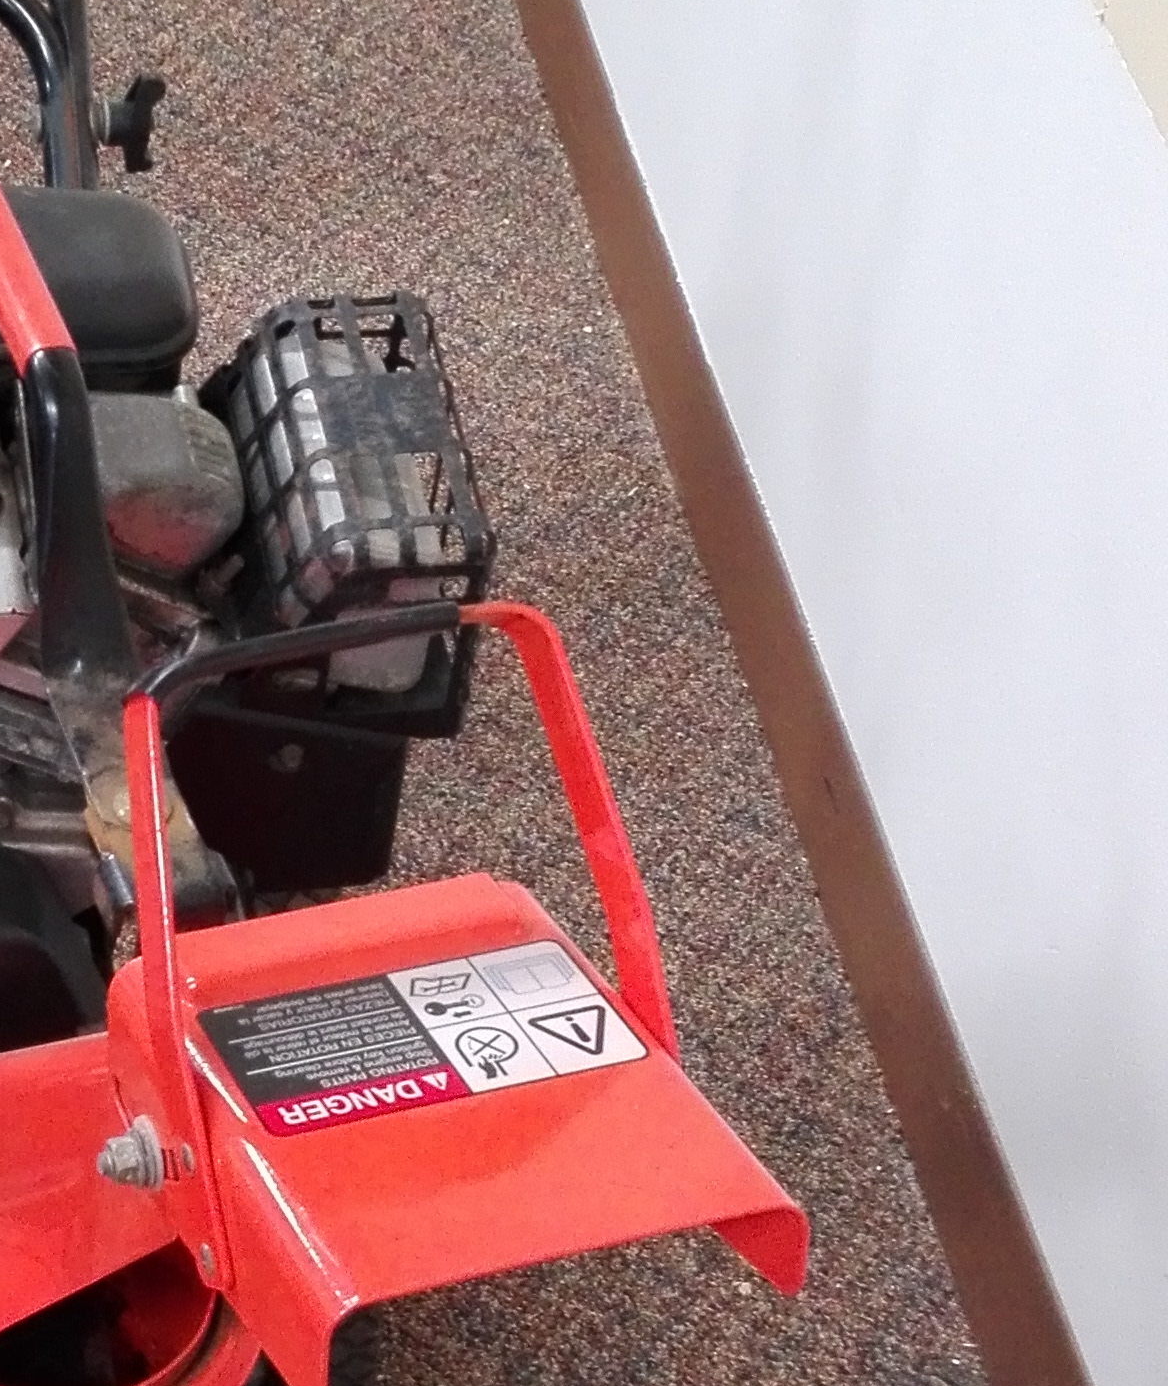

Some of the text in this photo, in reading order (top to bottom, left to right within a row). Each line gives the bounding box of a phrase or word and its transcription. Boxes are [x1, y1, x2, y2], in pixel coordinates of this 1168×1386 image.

[269, 1042, 339, 1064] ROTATION
[319, 1057, 439, 1088] ROTATING PARTS
[277, 1079, 423, 1125] DANGER
